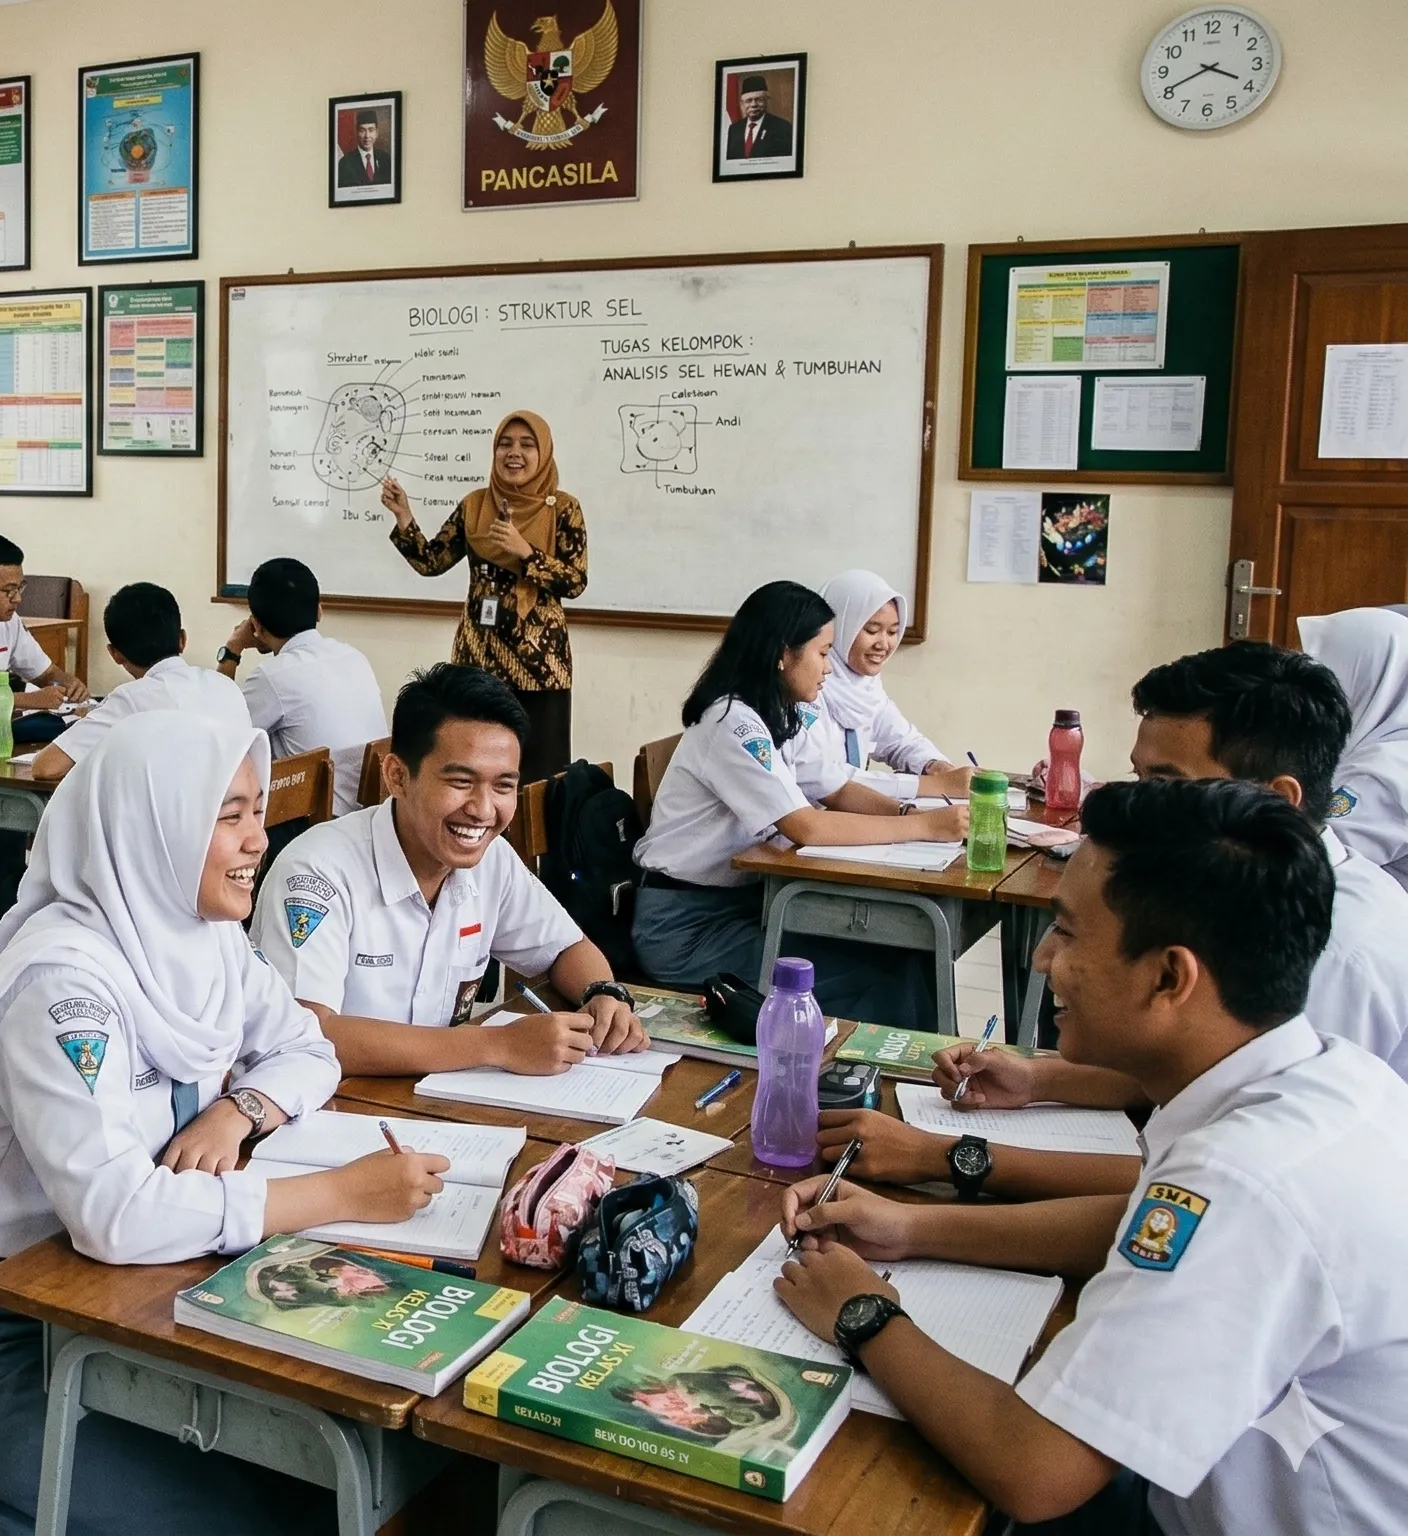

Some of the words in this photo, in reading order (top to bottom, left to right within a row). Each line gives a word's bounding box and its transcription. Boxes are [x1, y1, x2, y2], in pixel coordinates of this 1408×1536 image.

[1204, 19, 1221, 35] 12
[1232, 23, 1240, 37] 1
[1182, 28, 1196, 43] 11
[1246, 37, 1258, 51] 2
[1165, 45, 1182, 60] 10
[1251, 56, 1263, 71] 3
[1158, 65, 1169, 79] 9
[1163, 86, 1175, 100] 8
[1243, 79, 1254, 93] 4
[1180, 99, 1191, 113] 7
[1201, 103, 1213, 117] 6
[1226, 95, 1237, 110] 5
[481, 160, 619, 192] PANCASILA
[498, 300, 593, 322] STRUKTUR
[606, 298, 642, 317] SEL
[600, 338, 650, 355] TUGAS
[603, 364, 668, 382] ANALISIS
[678, 364, 705, 380] SEL
[713, 363, 767, 378] HEWAN
[775, 359, 785, 379] &
[793, 359, 882, 376] TUMBUHAN
[663, 484, 716, 496] Tumbuhan
[342, 509, 359, 520] Ibu
[364, 510, 385, 521] Sari
[385, 1288, 431, 1320] KELAS
[381, 1285, 476, 1350] BIOLOGI
[527, 1323, 620, 1395] BIOLOGI
[575, 1354, 623, 1390] KELAS
